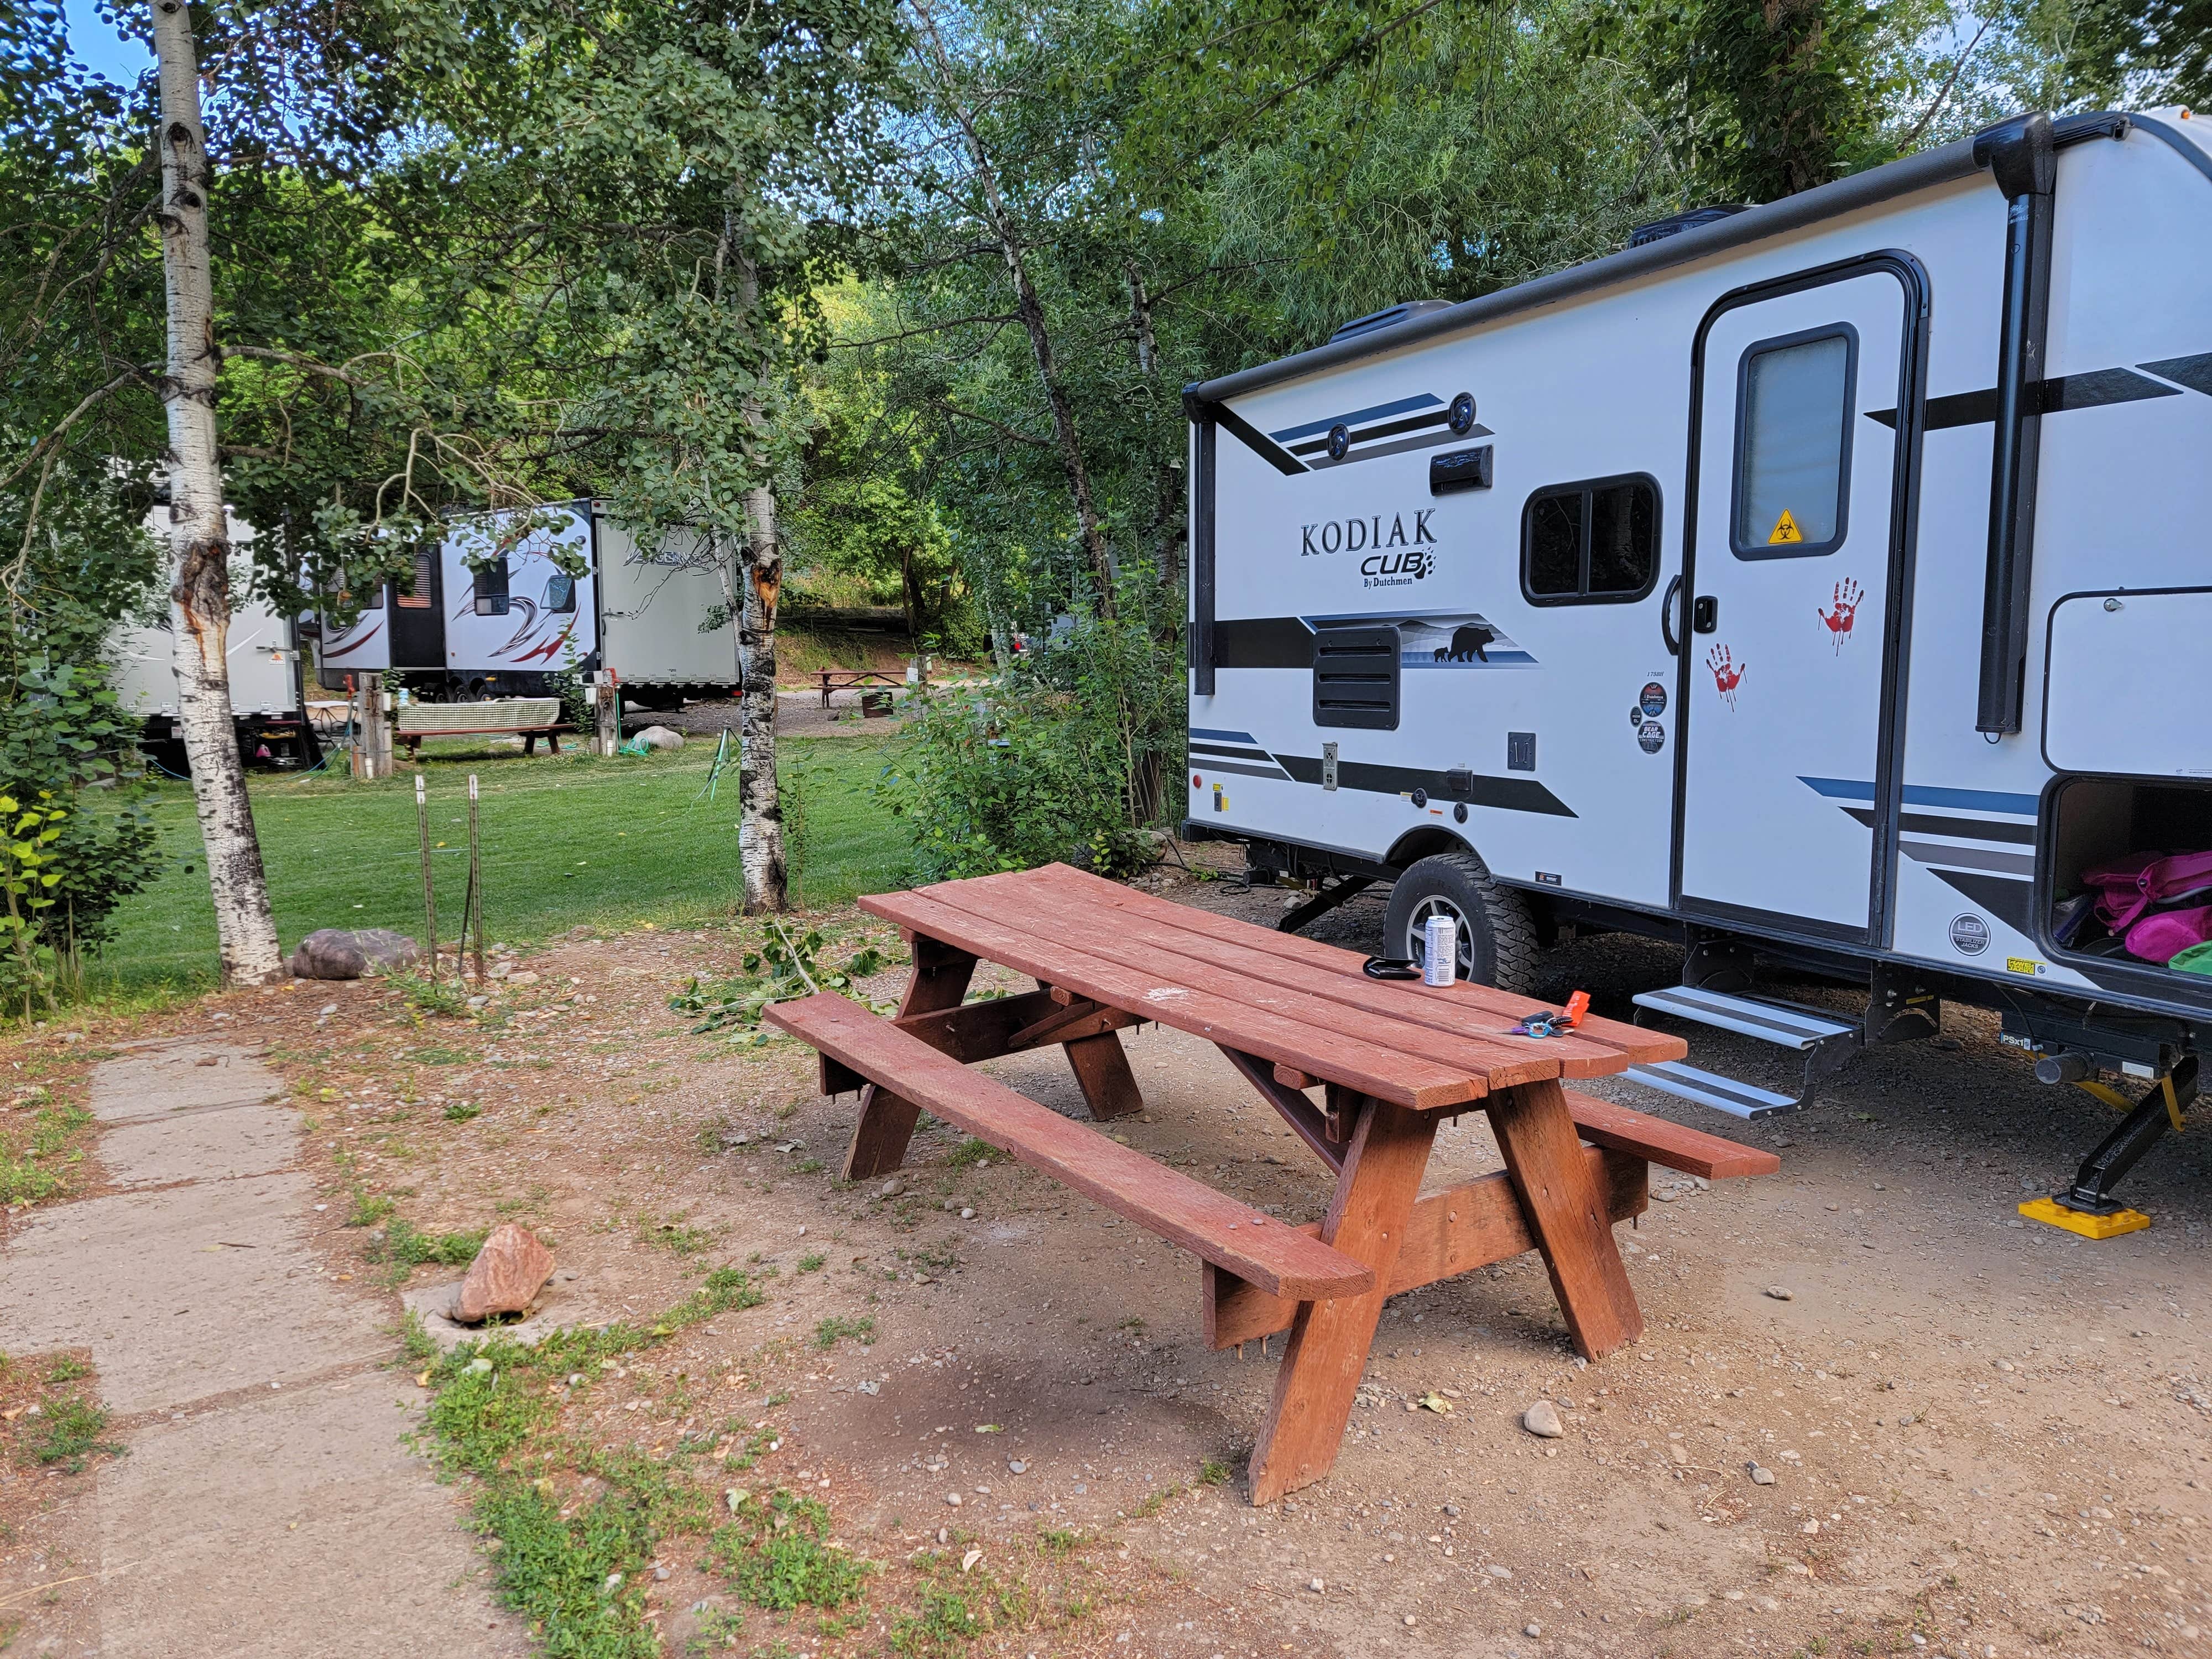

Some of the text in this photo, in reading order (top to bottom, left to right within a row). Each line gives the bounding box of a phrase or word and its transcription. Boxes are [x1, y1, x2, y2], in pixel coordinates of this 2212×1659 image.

[1301, 508, 1437, 556] KODIAK
[1360, 552, 1425, 576] CUB
[1364, 576, 1412, 589] By Dutchmen
[1958, 920, 1983, 933] LED
[1955, 937, 1985, 945] STABILIZER
